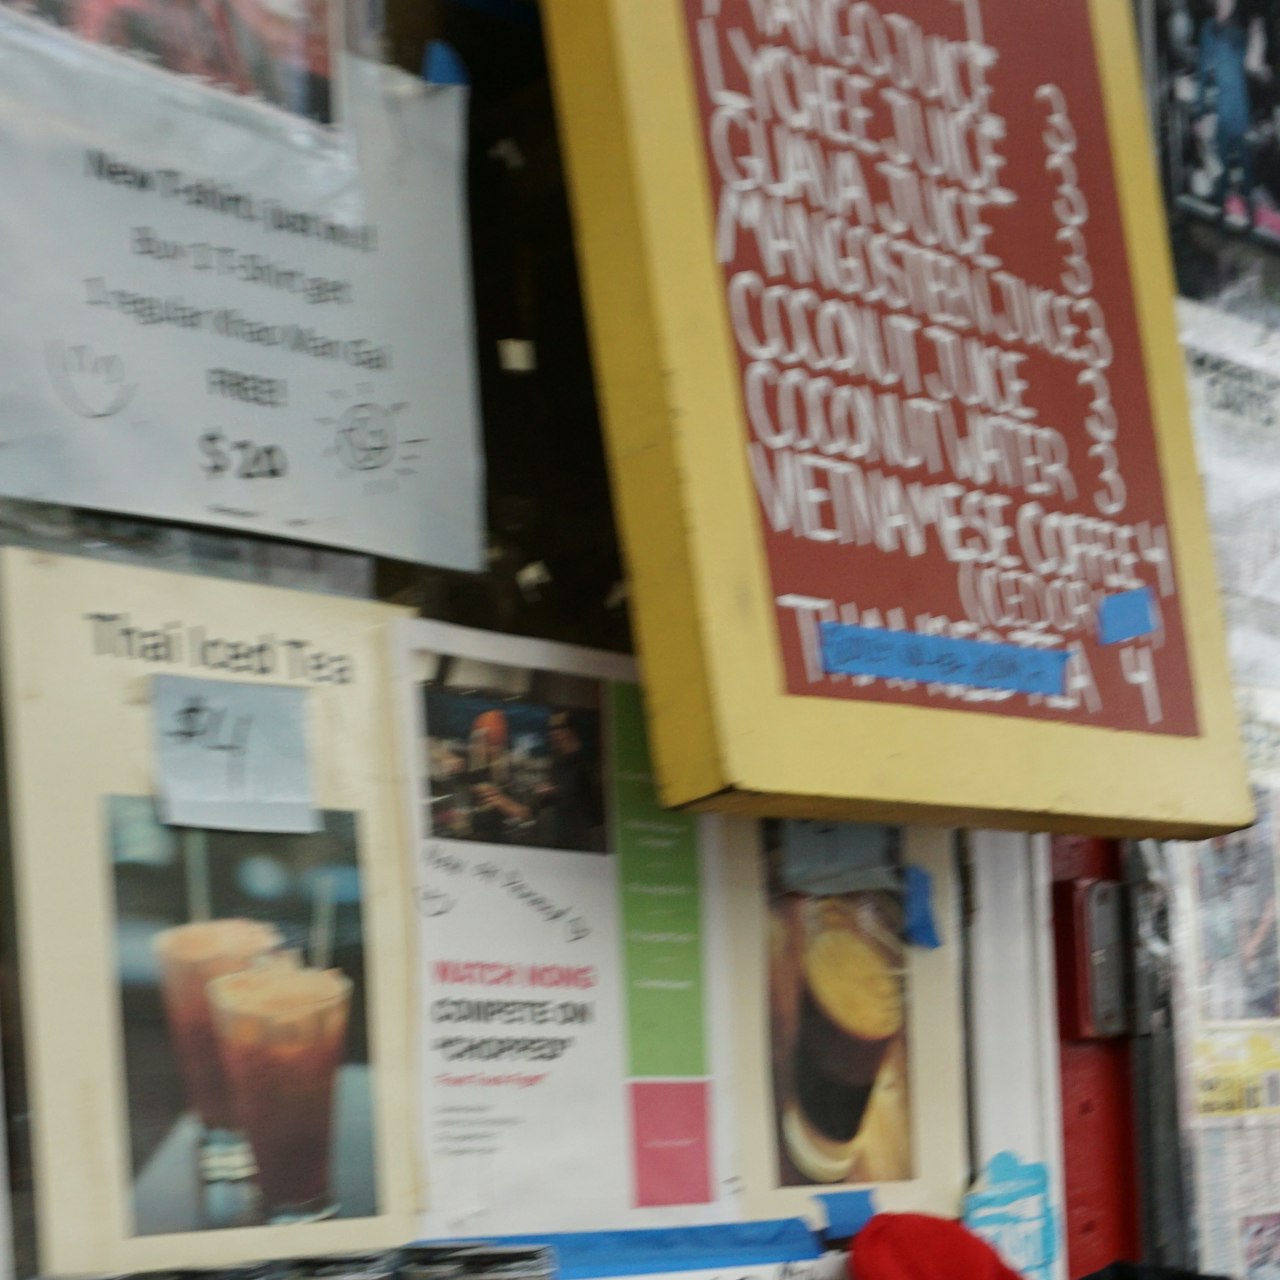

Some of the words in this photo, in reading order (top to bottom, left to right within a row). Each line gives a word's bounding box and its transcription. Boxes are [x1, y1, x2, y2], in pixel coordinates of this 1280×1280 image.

[1045, 154, 1089, 228] 3
[1055, 226, 1094, 297] 3
[728, 270, 922, 395] COCONUT
[922, 322, 1038, 420] JUICE
[1077, 367, 1118, 443] 3
[744, 358, 945, 474] COCONUT
[1088, 440, 1128, 516] 3
[84, 612, 184, 664] Thai
[188, 623, 280, 675] Iced
[282, 637, 358, 687] Tea
[1121, 645, 1163, 726] 4
